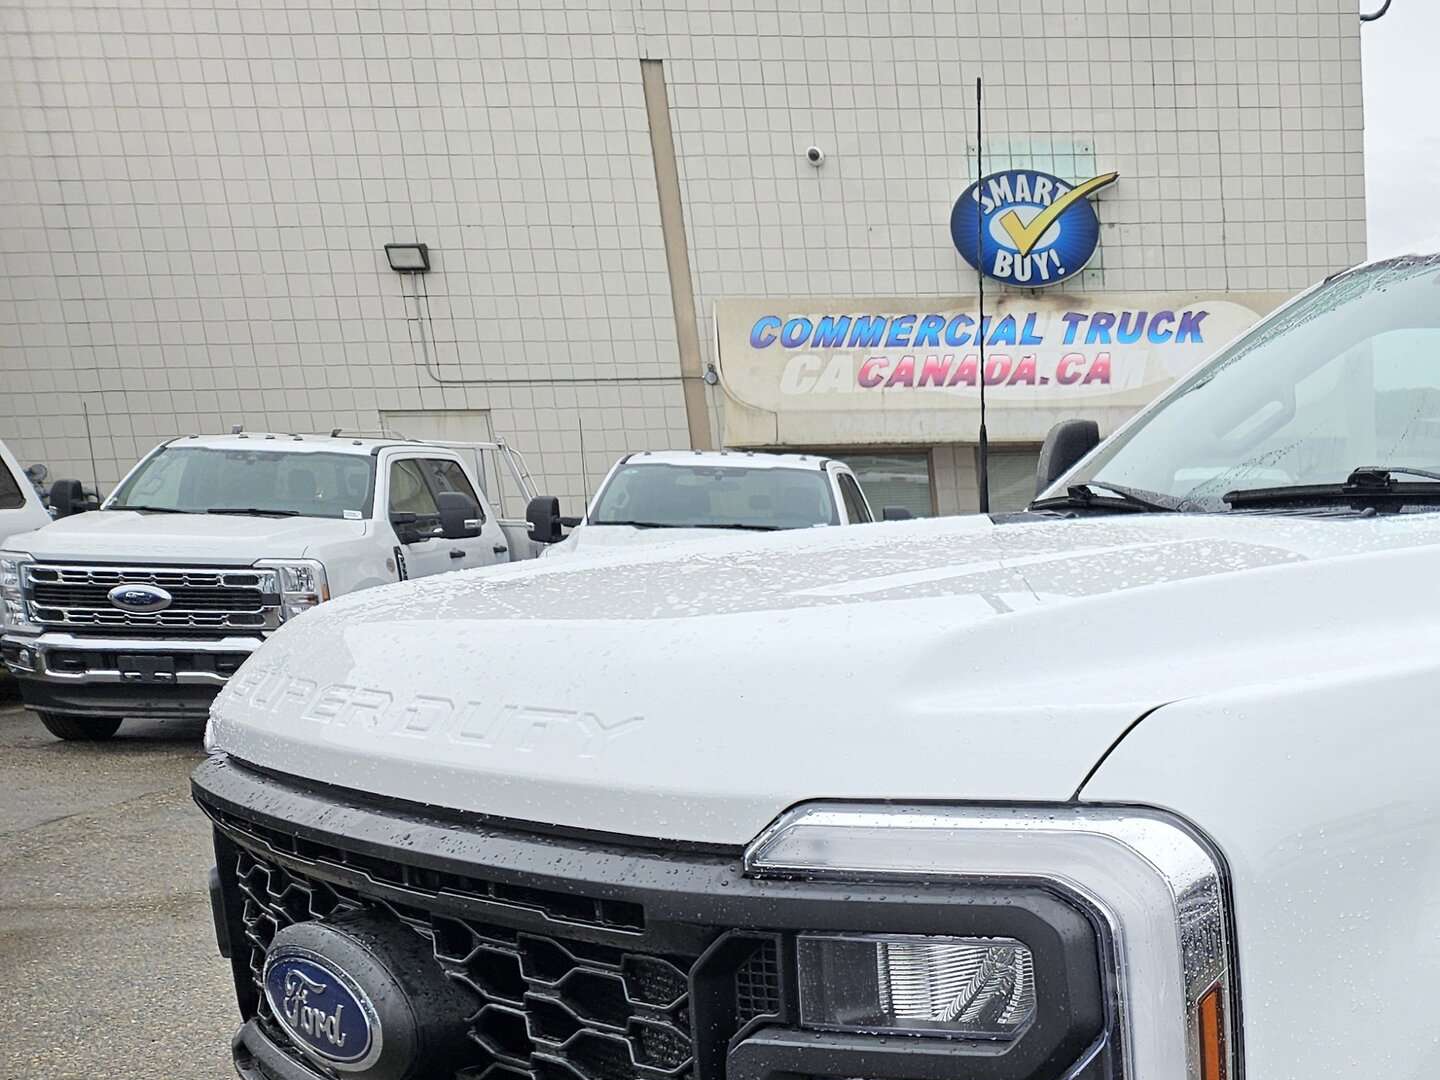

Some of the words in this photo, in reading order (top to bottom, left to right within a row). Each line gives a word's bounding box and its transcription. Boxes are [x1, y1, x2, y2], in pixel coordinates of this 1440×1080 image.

[972, 174, 1071, 215] SMART
[993, 249, 1065, 282] BUY!
[749, 312, 1044, 349] COMMERCIAL
[1062, 311, 1210, 344] TRUCK
[857, 352, 1111, 389] CANADA.CA
[229, 671, 394, 728] SUPER
[391, 695, 645, 760] DUTY
[284, 969, 347, 1047] Ford
